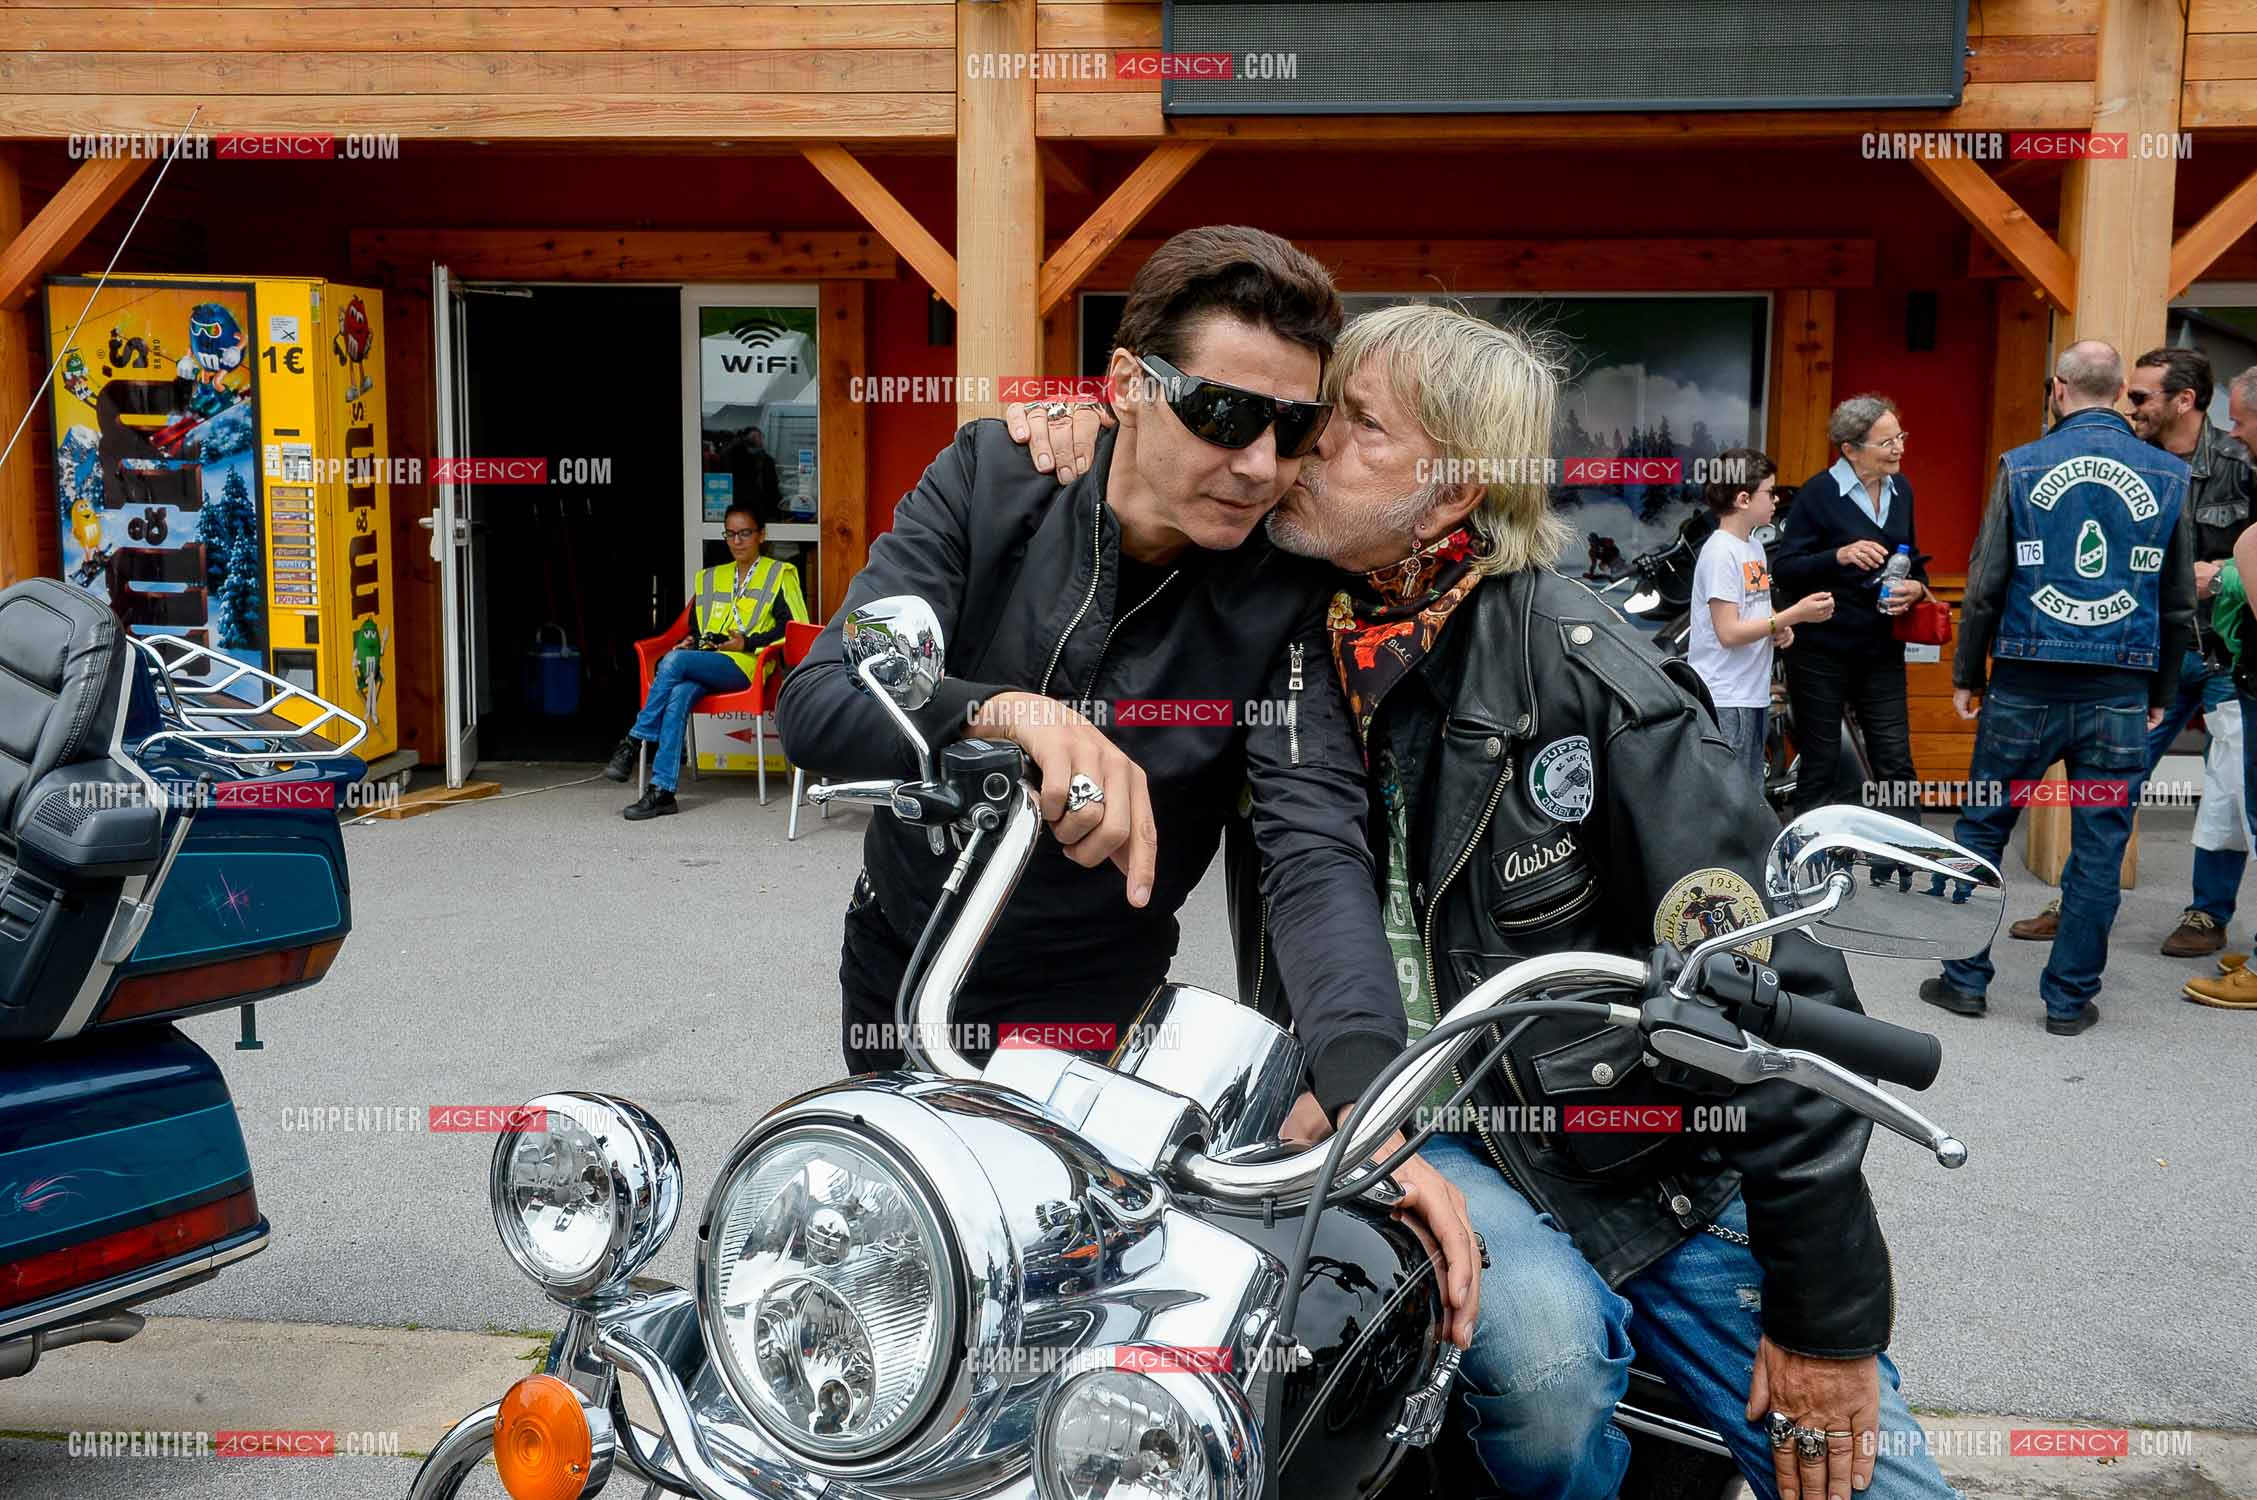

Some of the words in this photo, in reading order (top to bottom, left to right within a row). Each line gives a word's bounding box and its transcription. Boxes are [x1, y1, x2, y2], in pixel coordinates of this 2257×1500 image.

[721, 355, 798, 374] WiFi
[2032, 460, 2155, 517] BOOZEFIGHTERS
[2019, 543, 2041, 561] 176
[2132, 550, 2161, 569] MC
[2038, 590, 2079, 620] EST.
[2087, 595, 2132, 621] 1946
[1709, 878, 1742, 893] 1955
